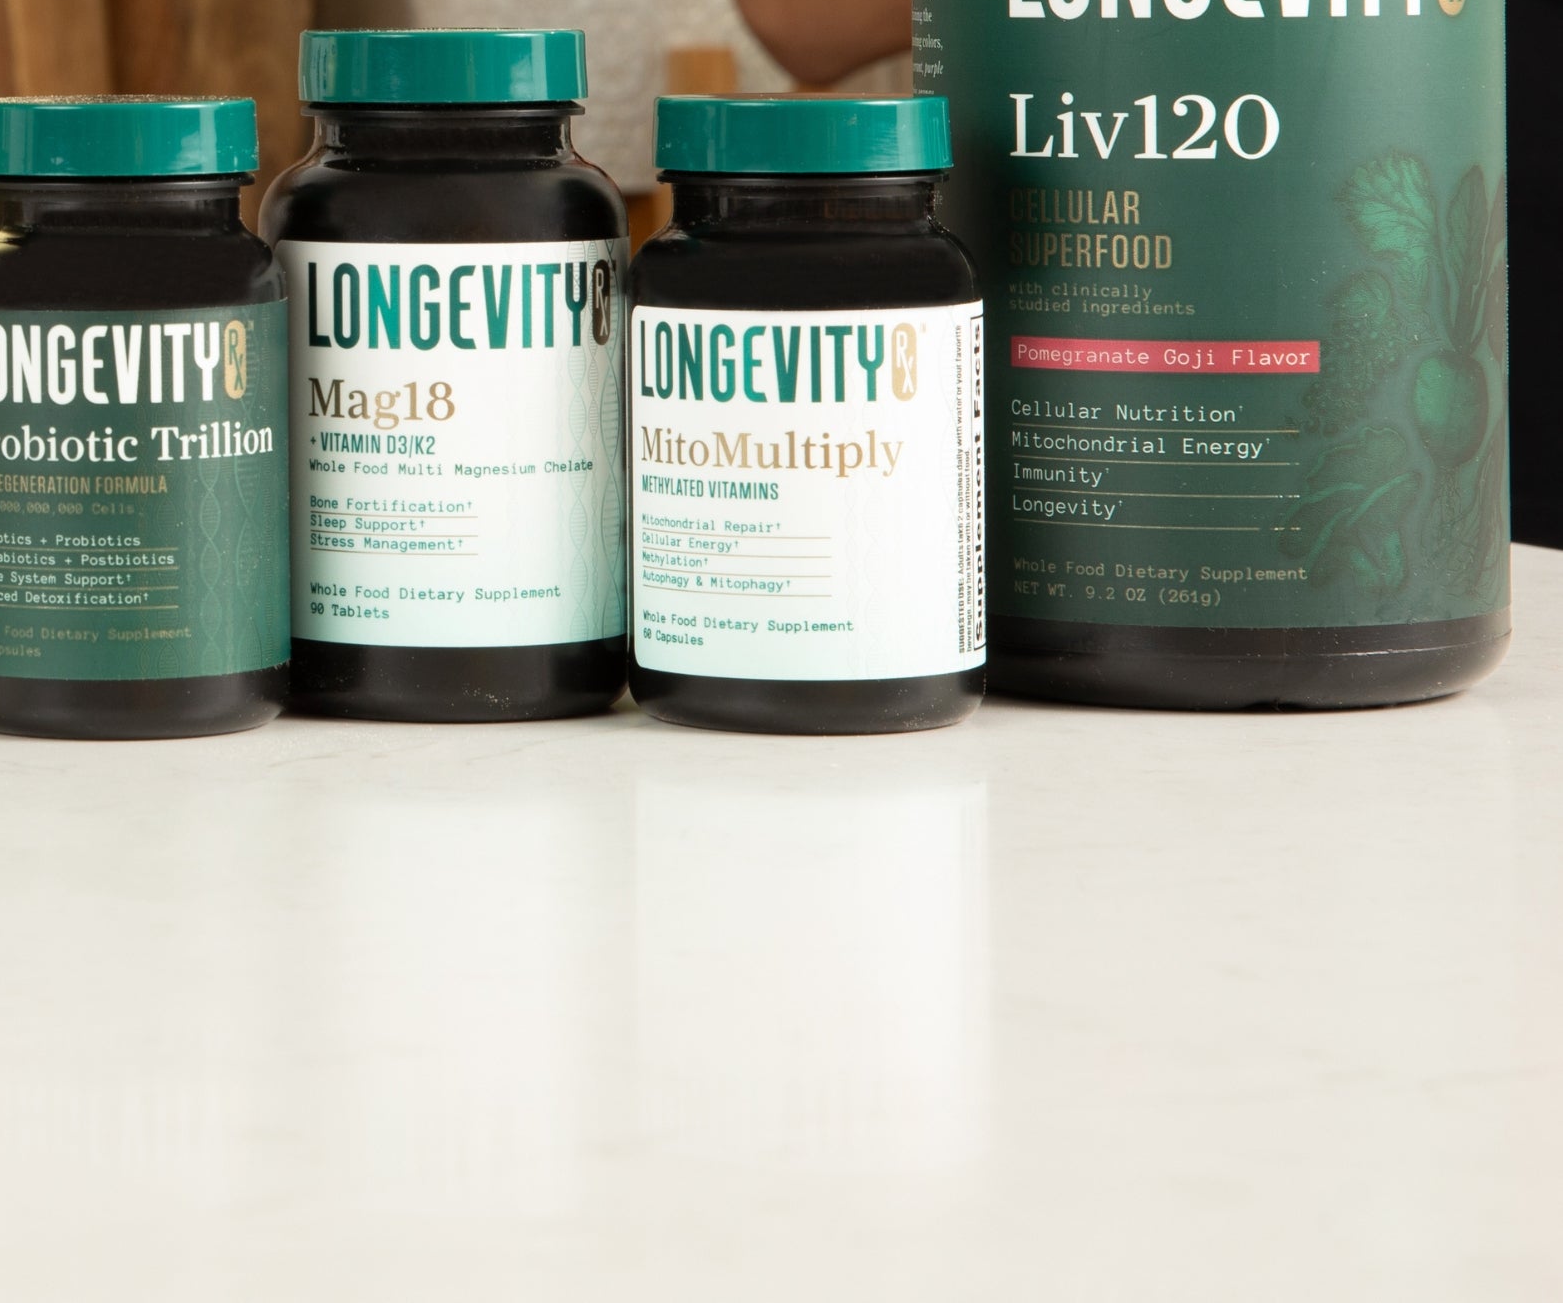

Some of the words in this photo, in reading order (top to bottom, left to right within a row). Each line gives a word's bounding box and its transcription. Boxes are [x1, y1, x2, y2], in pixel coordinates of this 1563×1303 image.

[1009, 92, 1280, 160] Liv120
[1010, 190, 1140, 225] CELLULAR
[1010, 233, 1173, 270] SUPERFOOD
[1009, 282, 1043, 296] with
[1052, 283, 1152, 301] clinically
[307, 260, 588, 351] LONGEVITY
[1009, 298, 1071, 313] studied
[1082, 300, 1196, 317] ingredients
[640, 320, 884, 403] LONGEVITY
[1018, 344, 1150, 366] Pomegranate
[1164, 349, 1215, 369] Goji
[1232, 350, 1310, 367] Flavor
[973, 323, 981, 419] Facts
[308, 378, 455, 430] Mag18
[1012, 399, 1101, 420] Cellular
[151, 422, 274, 460] Trillion
[321, 432, 381, 455] VITAMIN
[387, 435, 436, 458] D3/K2
[641, 425, 905, 478] MitoMultiply
[1012, 431, 1166, 454] Mitochondrial
[309, 458, 346, 473] Whole
[354, 461, 388, 474] Food
[398, 463, 443, 476] Multi
[455, 463, 536, 479] Magnesium
[544, 459, 594, 473] Chelate
[95, 475, 168, 495] FORMULA
[642, 474, 704, 497] METHYLATED
[708, 481, 779, 501] VITAMINS
[92, 501, 135, 515] Cells
[310, 496, 339, 510] Bone
[310, 514, 347, 531] Sleep
[642, 513, 715, 531] Mitochondrial
[55, 534, 141, 547] Probiotics
[310, 533, 355, 548] Stress
[642, 531, 683, 547] Cellular
[974, 432, 984, 642] Supplement
[80, 554, 175, 567] Postbiotics
[1014, 556, 1056, 573] Whole
[1066, 560, 1105, 577] Food
[1116, 564, 1189, 582] Dietary
[1201, 566, 1308, 583] Supplement
[10, 571, 57, 586] System
[642, 569, 689, 588] Autophagy
[696, 576, 704, 587] &
[310, 582, 347, 598] Whole
[355, 585, 390, 599] Food
[399, 587, 465, 603] Dietary
[475, 585, 561, 602] Supplement
[1014, 581, 1041, 595] NET
[1085, 586, 1115, 600] 9.2
[1125, 587, 1146, 602] OZ
[1158, 588, 1222, 607] (261g)
[310, 602, 325, 616] 90
[332, 604, 390, 620] Tablets
[643, 608, 667, 624] Whole
[671, 613, 697, 627] Food
[704, 616, 759, 633] Dietary
[767, 620, 854, 634] Supplement
[4, 624, 34, 638] Food
[41, 627, 100, 642] Dietary
[107, 626, 192, 642] Supplement
[643, 627, 653, 640] 60
[655, 628, 705, 647] Capsules
